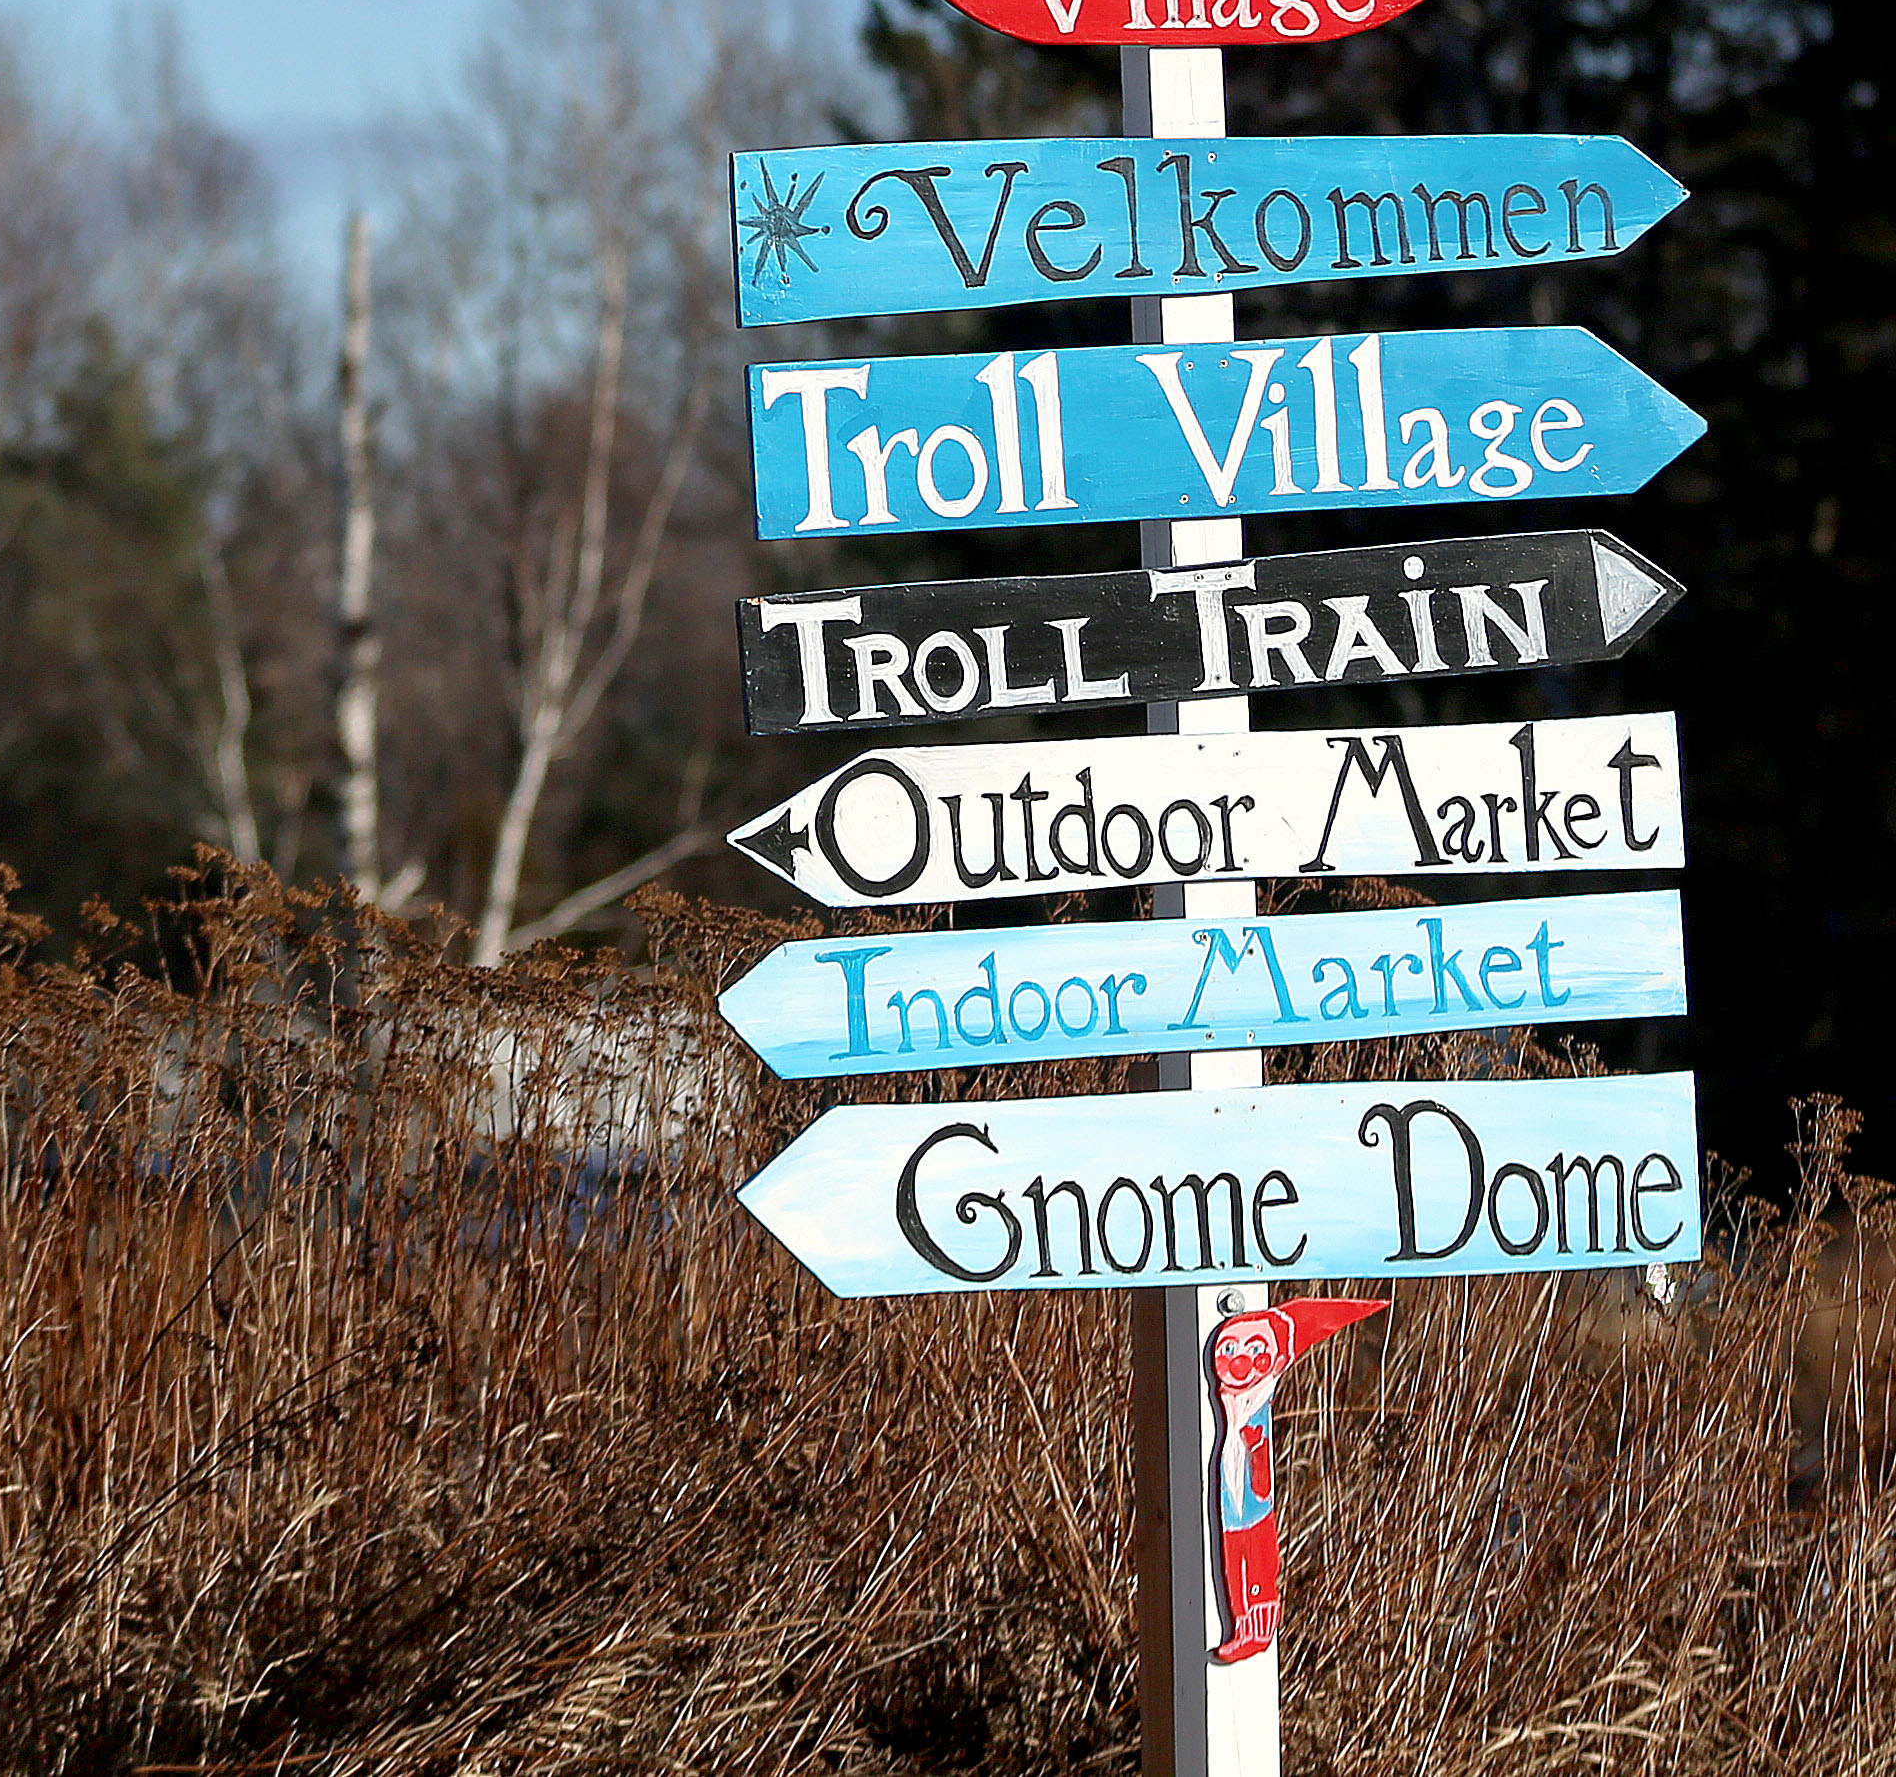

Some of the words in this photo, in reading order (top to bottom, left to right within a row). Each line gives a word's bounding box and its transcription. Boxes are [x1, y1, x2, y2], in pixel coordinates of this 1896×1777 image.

[844, 154, 1622, 289] Velkommen
[761, 349, 1080, 533] Troll
[1135, 333, 1595, 509] Village
[759, 595, 1131, 728] TROLL
[1147, 553, 1551, 693] TRAIN
[813, 756, 1256, 898] Outdoor
[1297, 722, 1662, 874] Market
[814, 944, 1148, 1062] Indoor
[1166, 916, 1574, 1030] Market
[894, 1121, 1309, 1284] Gnome
[1356, 1098, 1686, 1263] Dome
